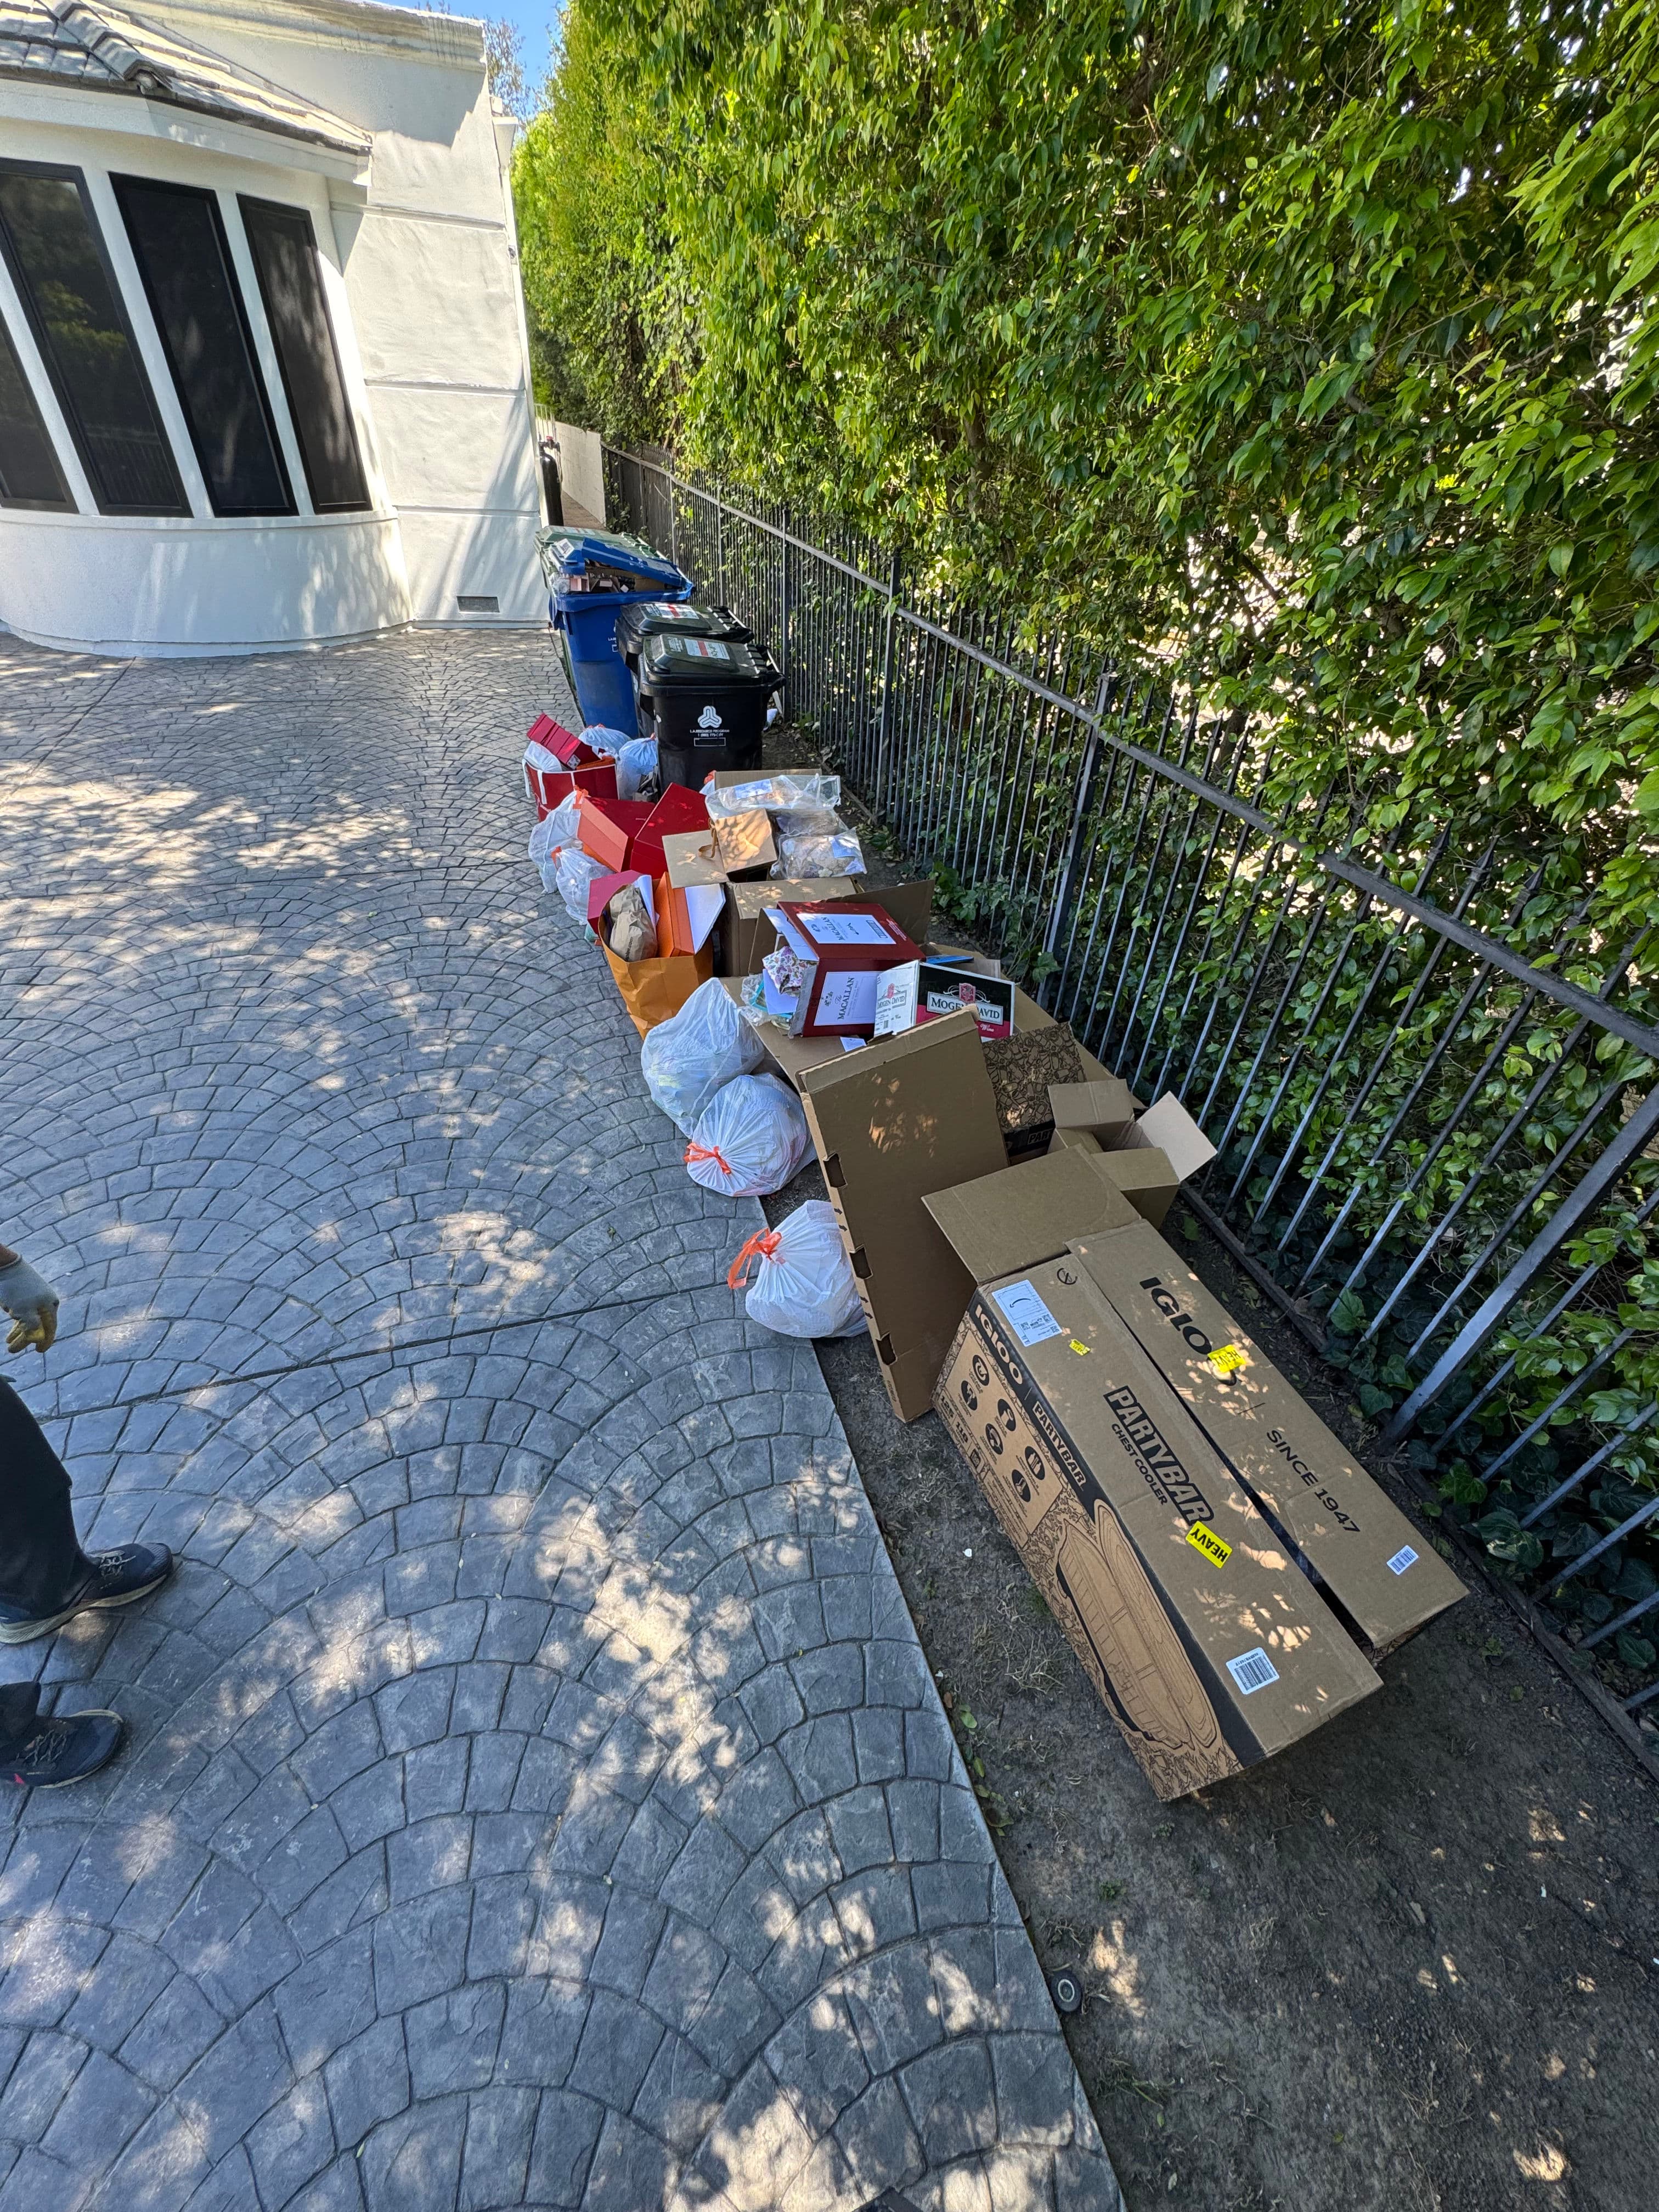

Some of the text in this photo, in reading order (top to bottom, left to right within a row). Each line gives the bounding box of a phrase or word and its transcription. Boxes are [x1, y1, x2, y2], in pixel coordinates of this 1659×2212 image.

[821, 917, 845, 940] MACALLAN
[837, 977, 855, 1020] MACALLAN
[891, 996, 905, 1005] DAVID
[978, 1006, 1000, 1019] AVID
[1214, 1350, 1242, 1367] HEAVY
[975, 1305, 1086, 1486] IGLOO PARTYBAR
[1103, 1386, 1214, 1525] PARTYBAR
[1111, 1423, 1167, 1505] CHEST COOLER
[1266, 1430, 1361, 1532] SINCE 1947
[1190, 1528, 1228, 1562] HEAVY
